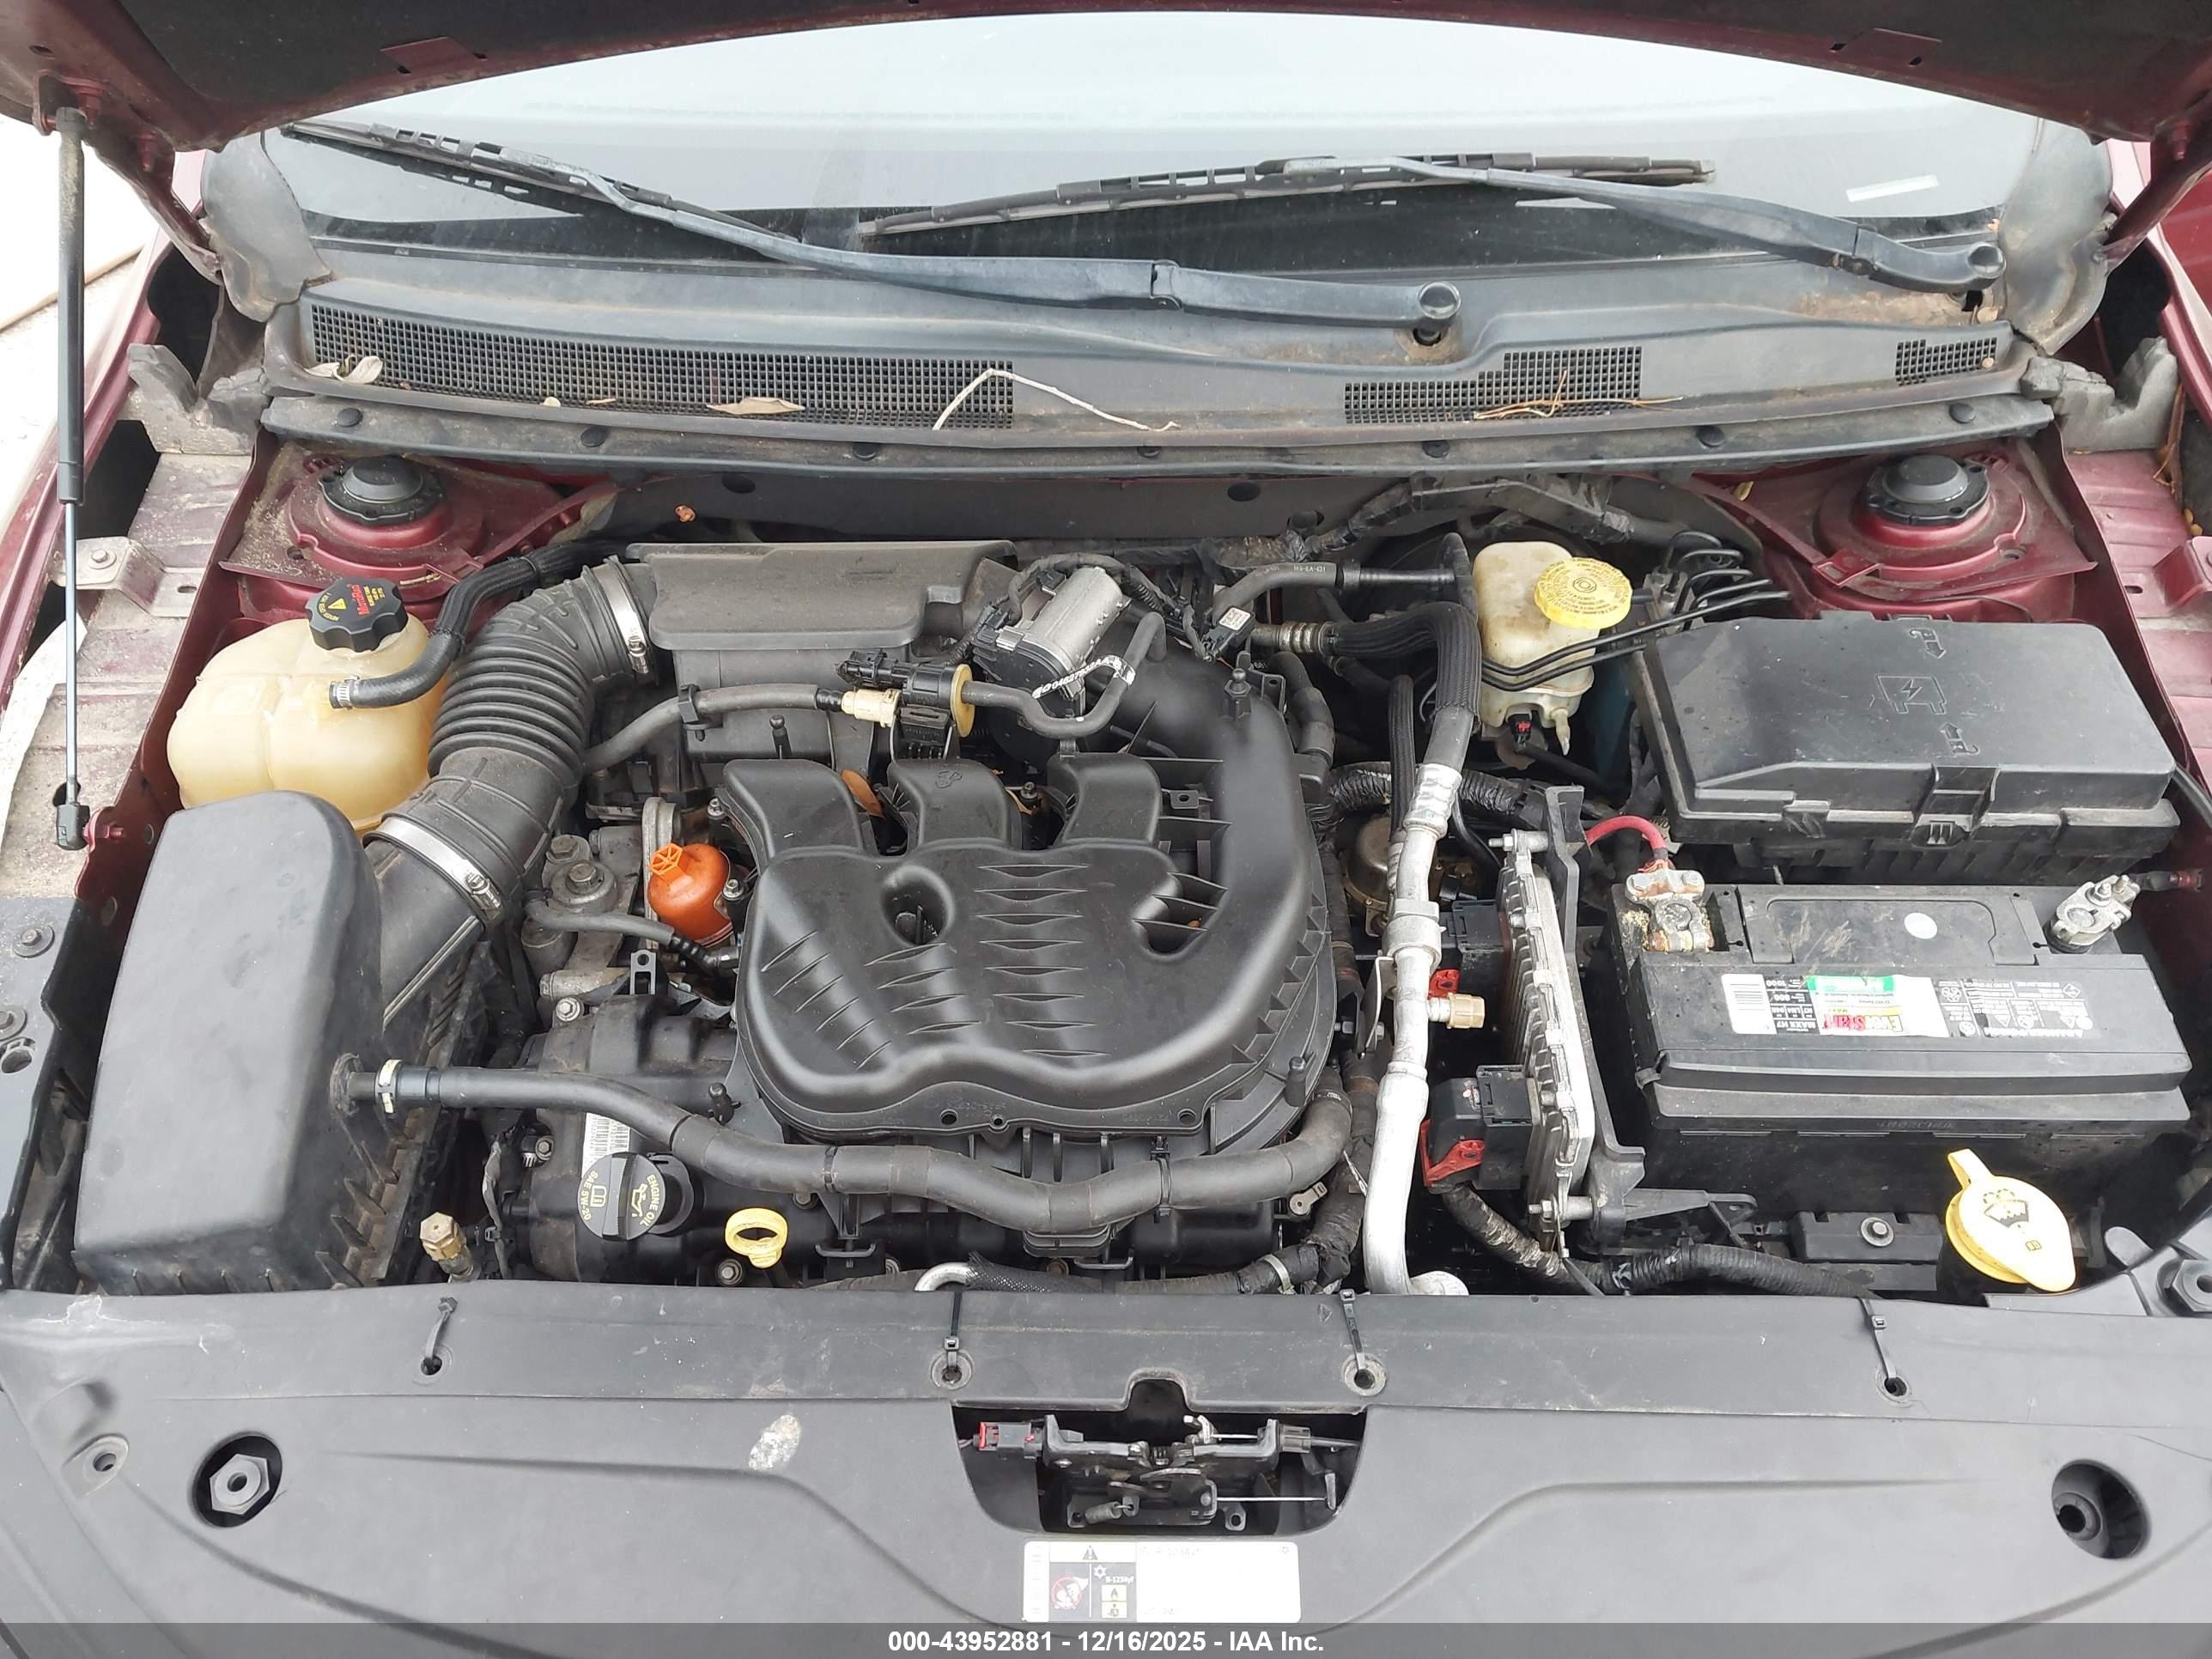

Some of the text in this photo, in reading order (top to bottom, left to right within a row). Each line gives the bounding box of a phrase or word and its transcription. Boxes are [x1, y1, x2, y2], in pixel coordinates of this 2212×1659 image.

[579, 1170, 599, 1222] SAE 5W-20
[639, 1173, 661, 1228] ENGINE OIL
